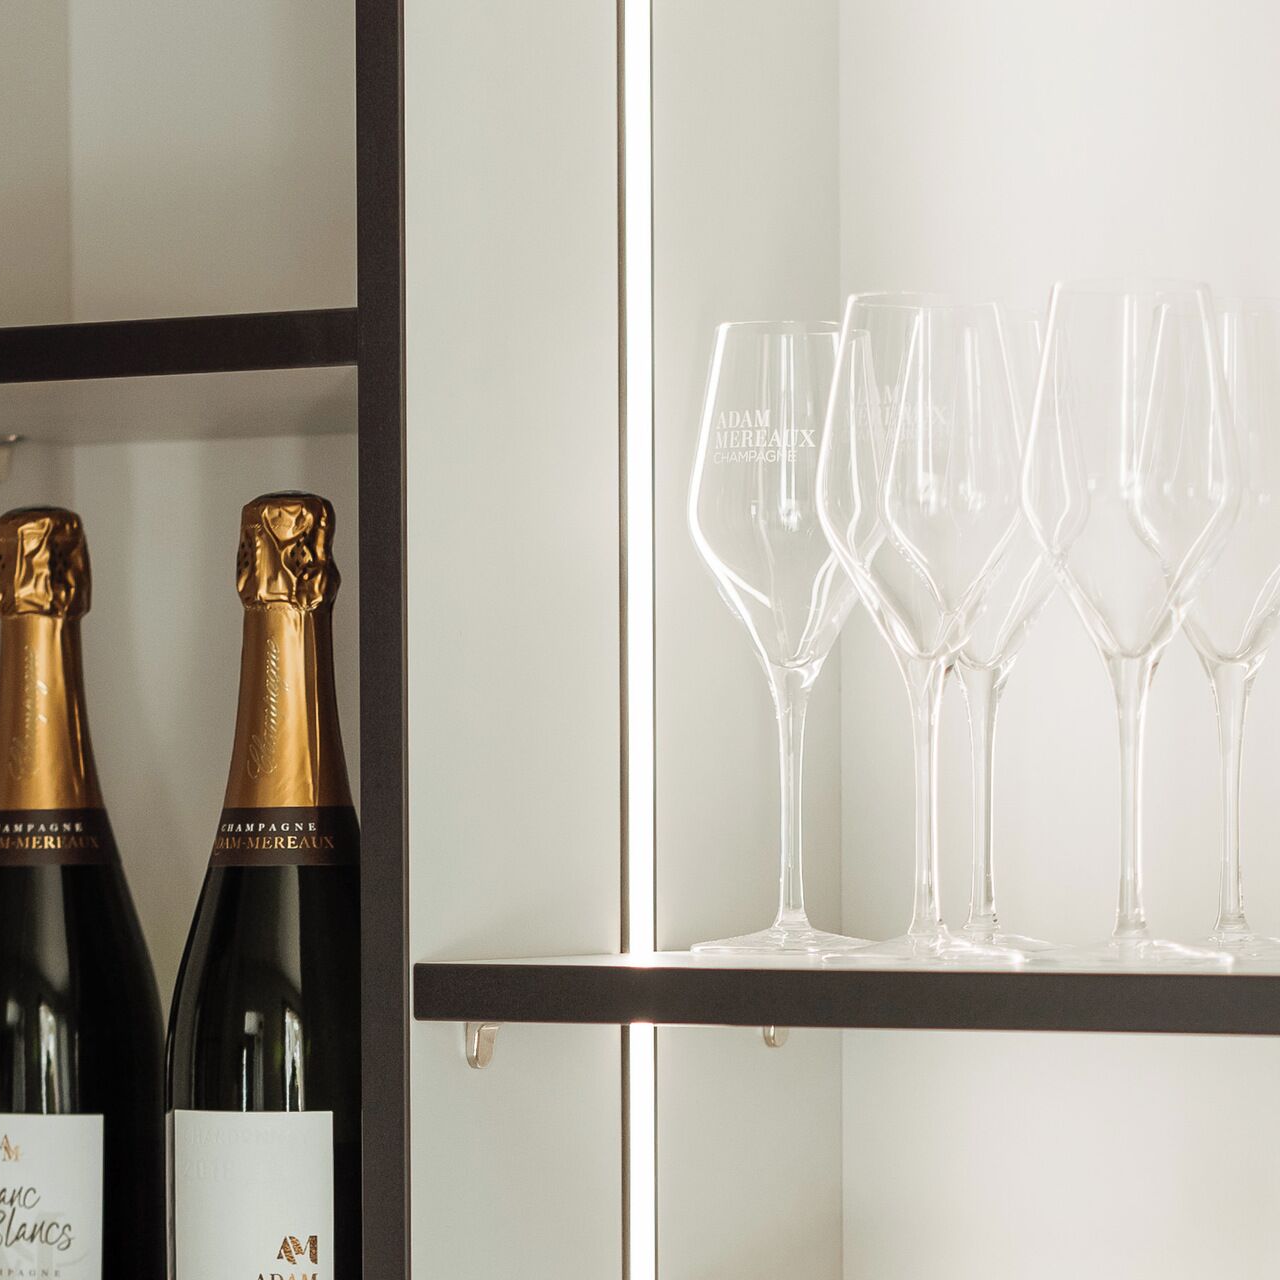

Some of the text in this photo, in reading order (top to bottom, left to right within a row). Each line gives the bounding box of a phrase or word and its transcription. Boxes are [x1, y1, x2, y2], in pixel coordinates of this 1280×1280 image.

[717, 409, 771, 429] ADAM
[715, 429, 817, 449] MEREAUX
[713, 450, 797, 464] CHAMPAGNE
[221, 822, 317, 832] CHAMPAGNE
